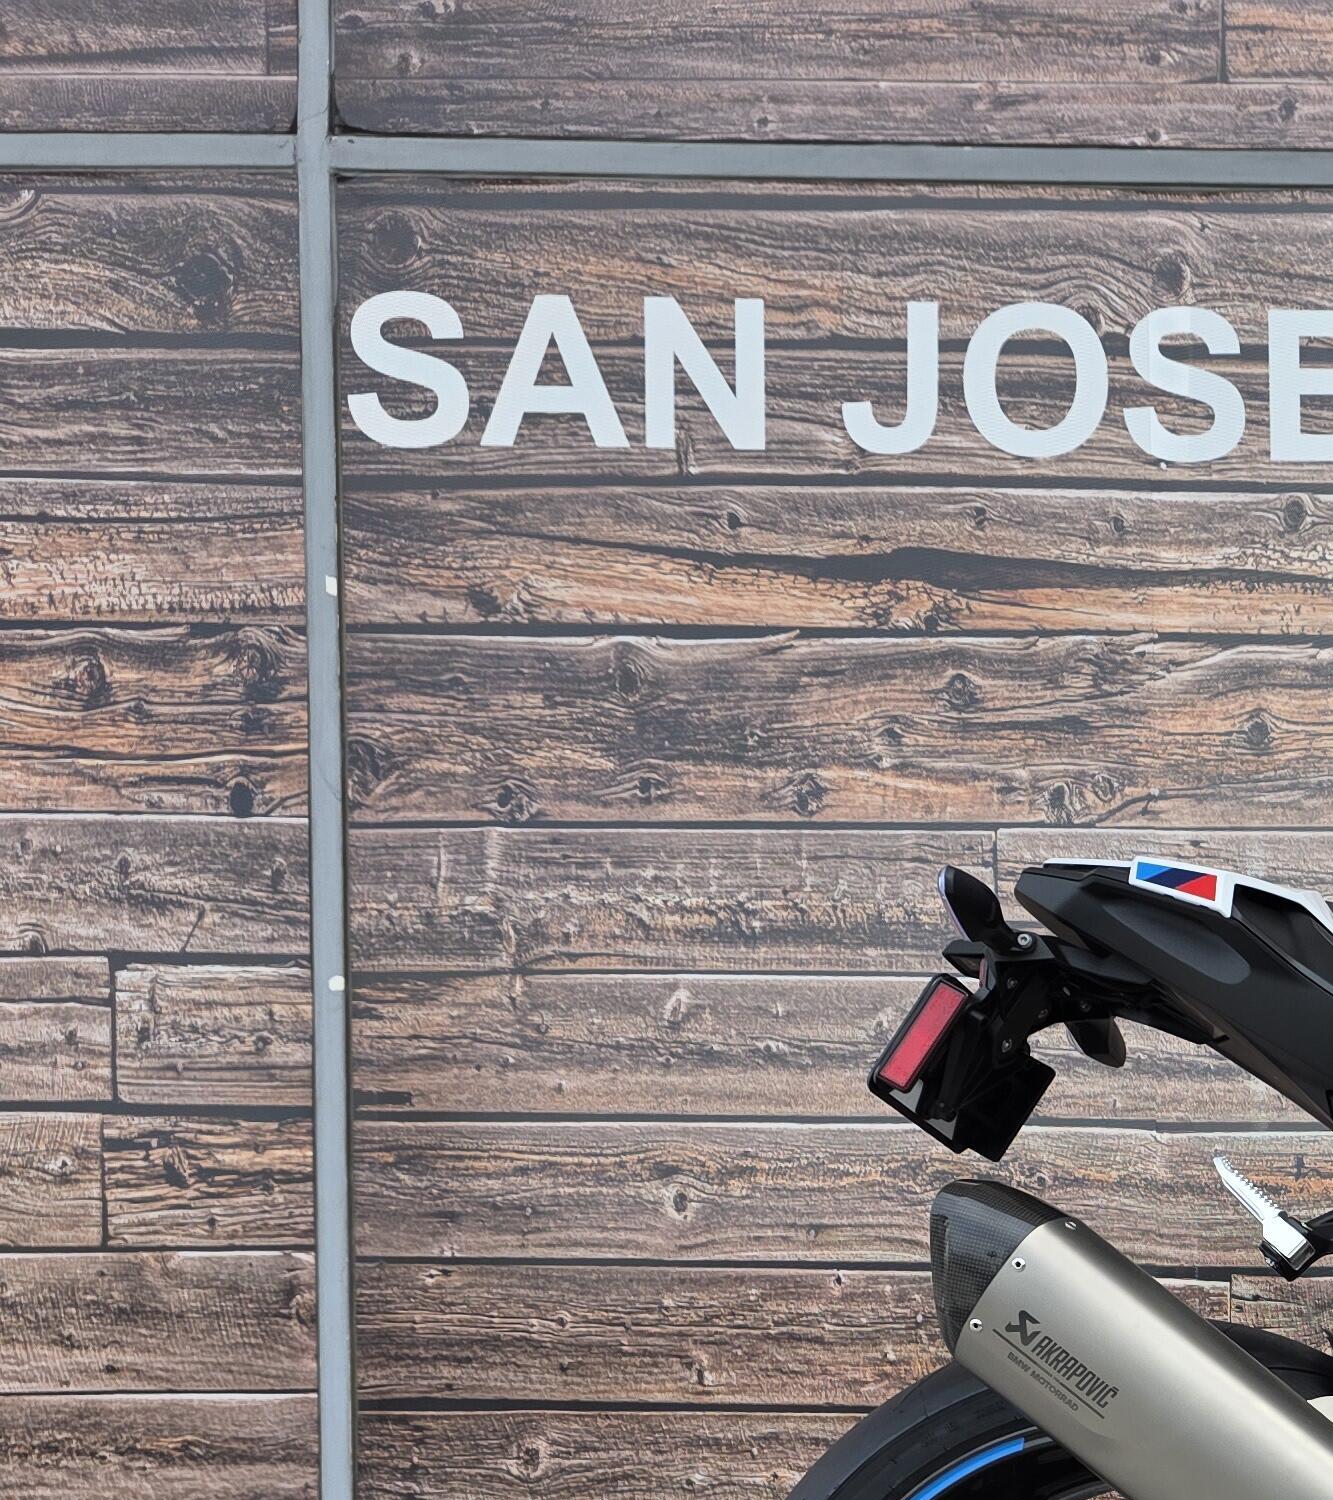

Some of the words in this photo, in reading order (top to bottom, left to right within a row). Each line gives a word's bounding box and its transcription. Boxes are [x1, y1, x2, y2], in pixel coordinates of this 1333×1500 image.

[346, 290, 766, 451] SAN
[1007, 1351, 1031, 1372] BMW
[1030, 1370, 1079, 1412] MOTORRAD
